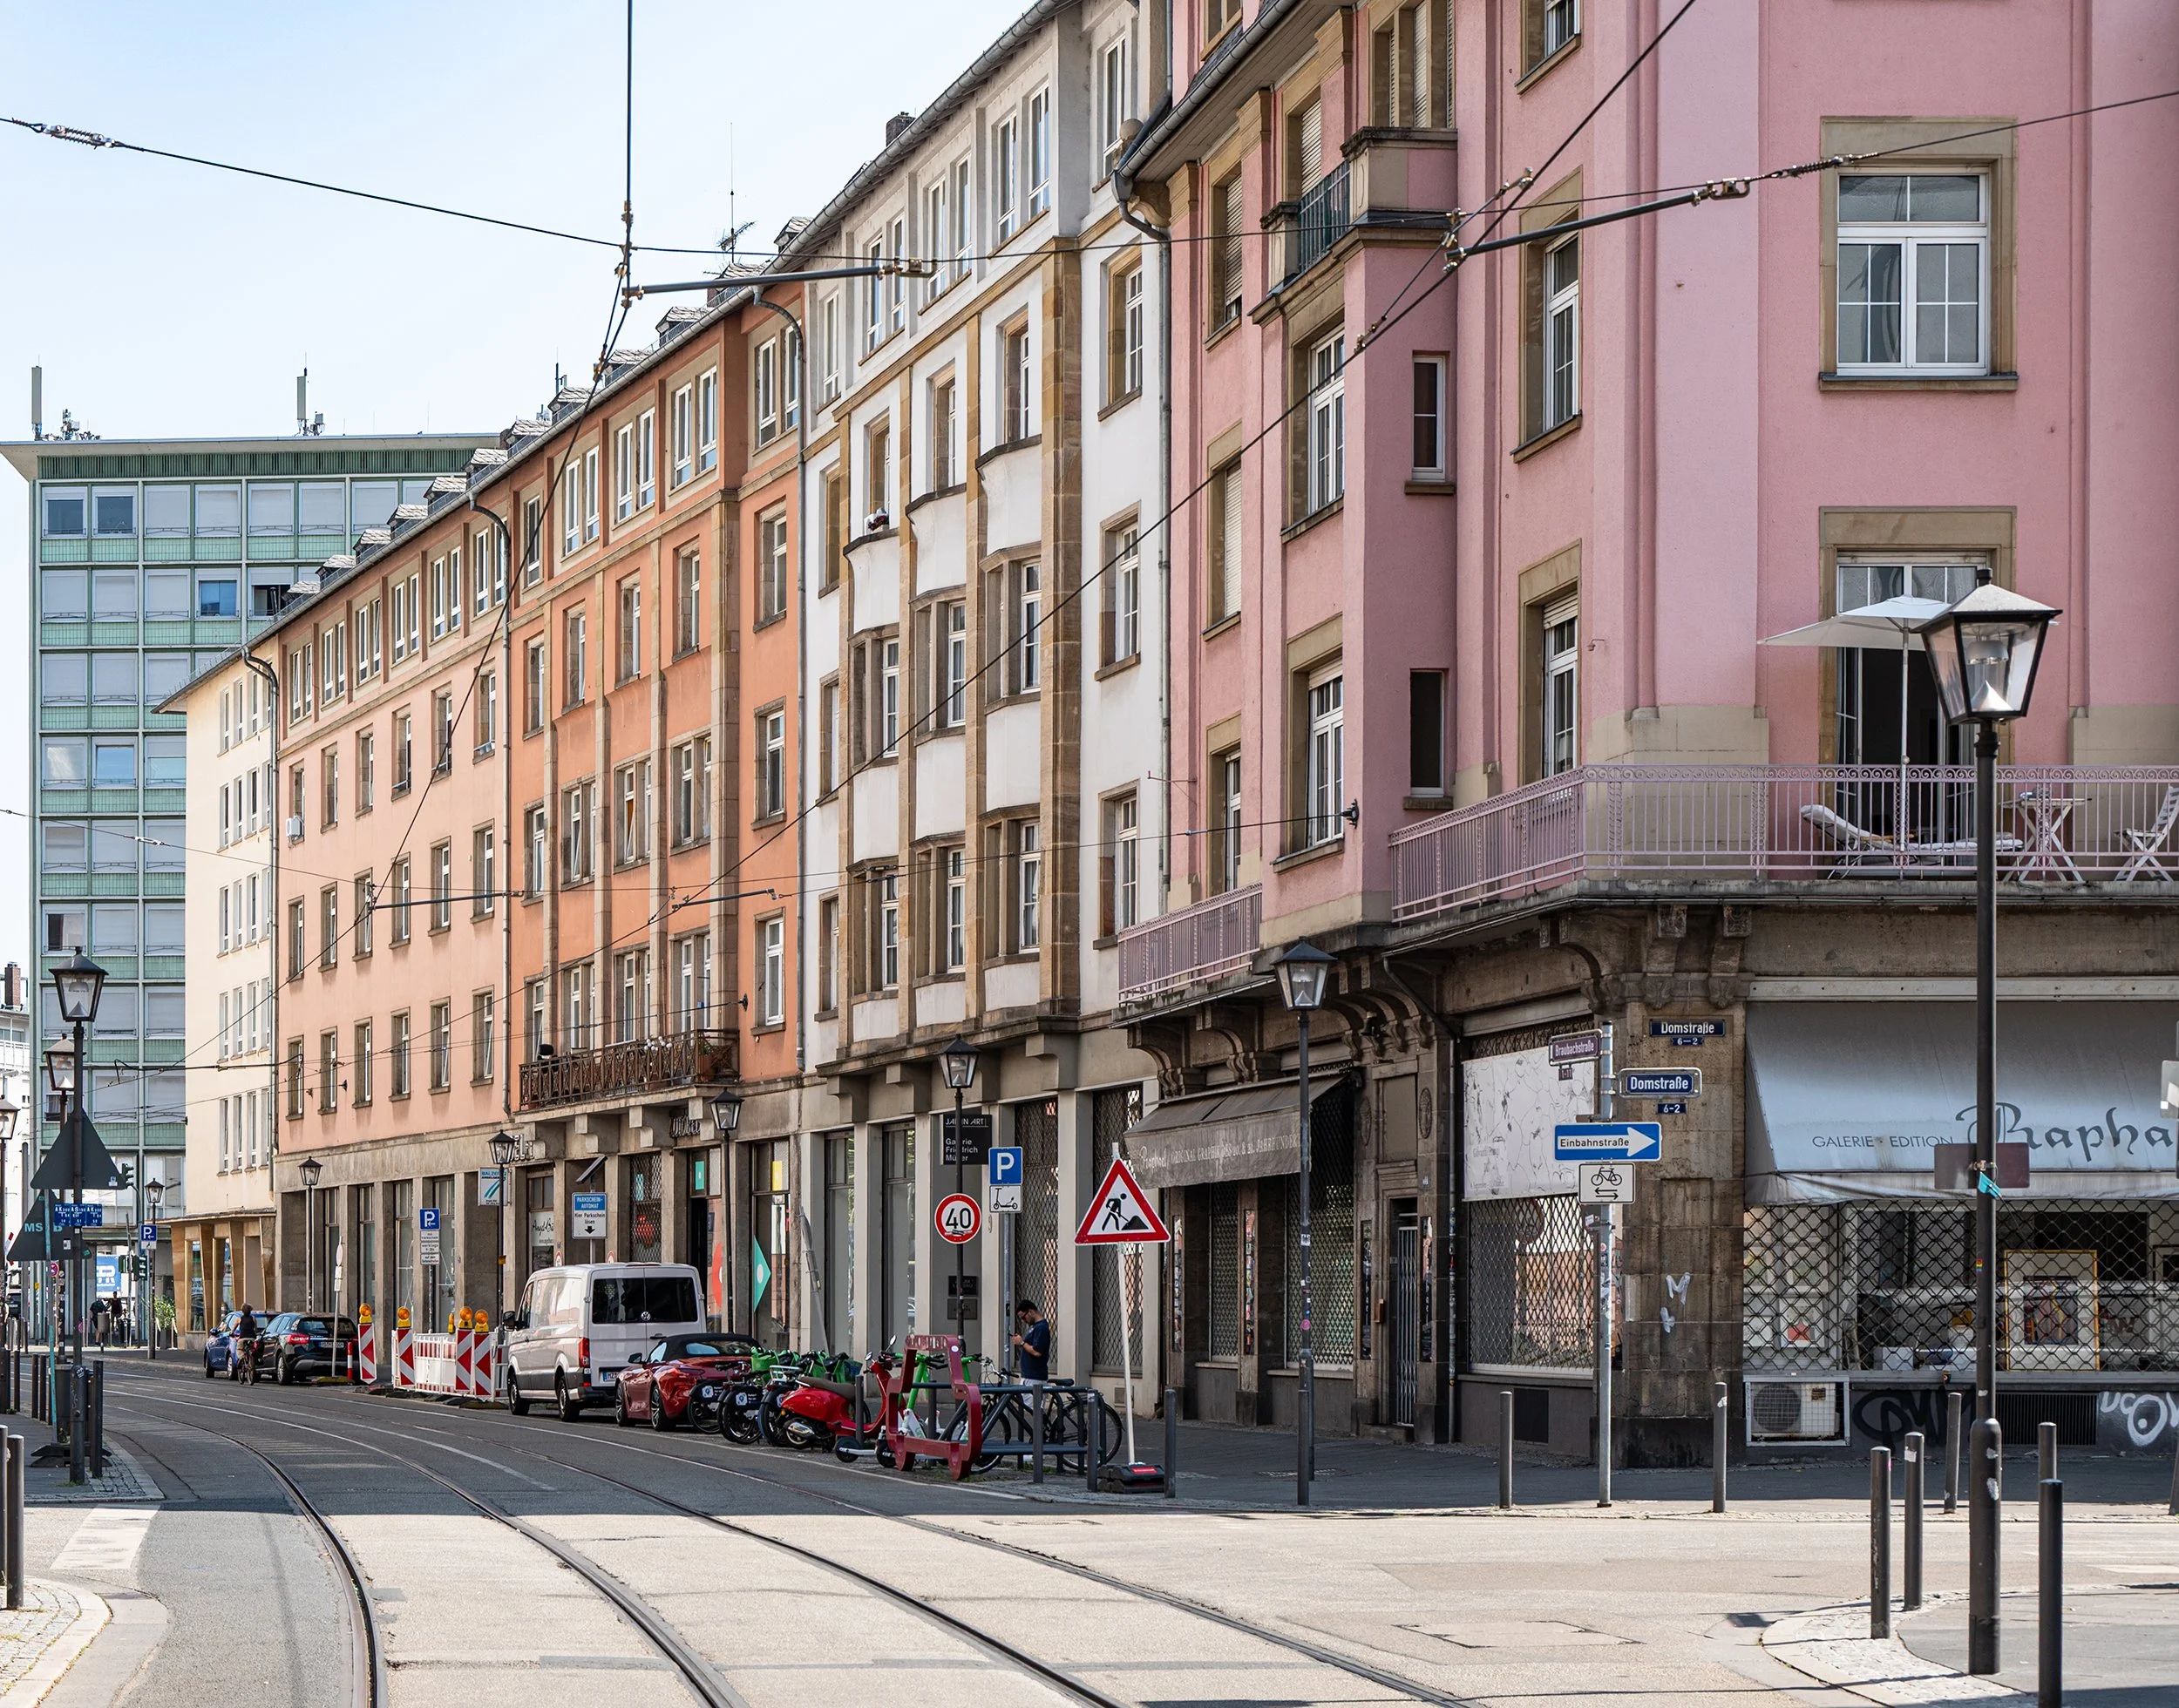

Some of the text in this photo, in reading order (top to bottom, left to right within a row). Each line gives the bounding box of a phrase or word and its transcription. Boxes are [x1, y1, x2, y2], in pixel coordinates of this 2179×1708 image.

[1661, 1021, 1714, 1034] Domstraße
[1555, 1040, 1595, 1057] Braubachstraße
[1630, 1076, 1689, 1090] Domstraße
[1663, 1104, 1680, 1114] 6-2
[1560, 1137, 1630, 1148] Einbahnstraße
[1812, 1135, 1874, 1148] GALERIE
[997, 1152, 1015, 1181] P
[424, 1211, 436, 1228] P
[945, 1208, 972, 1230] 40
[143, 1226, 153, 1239] P
